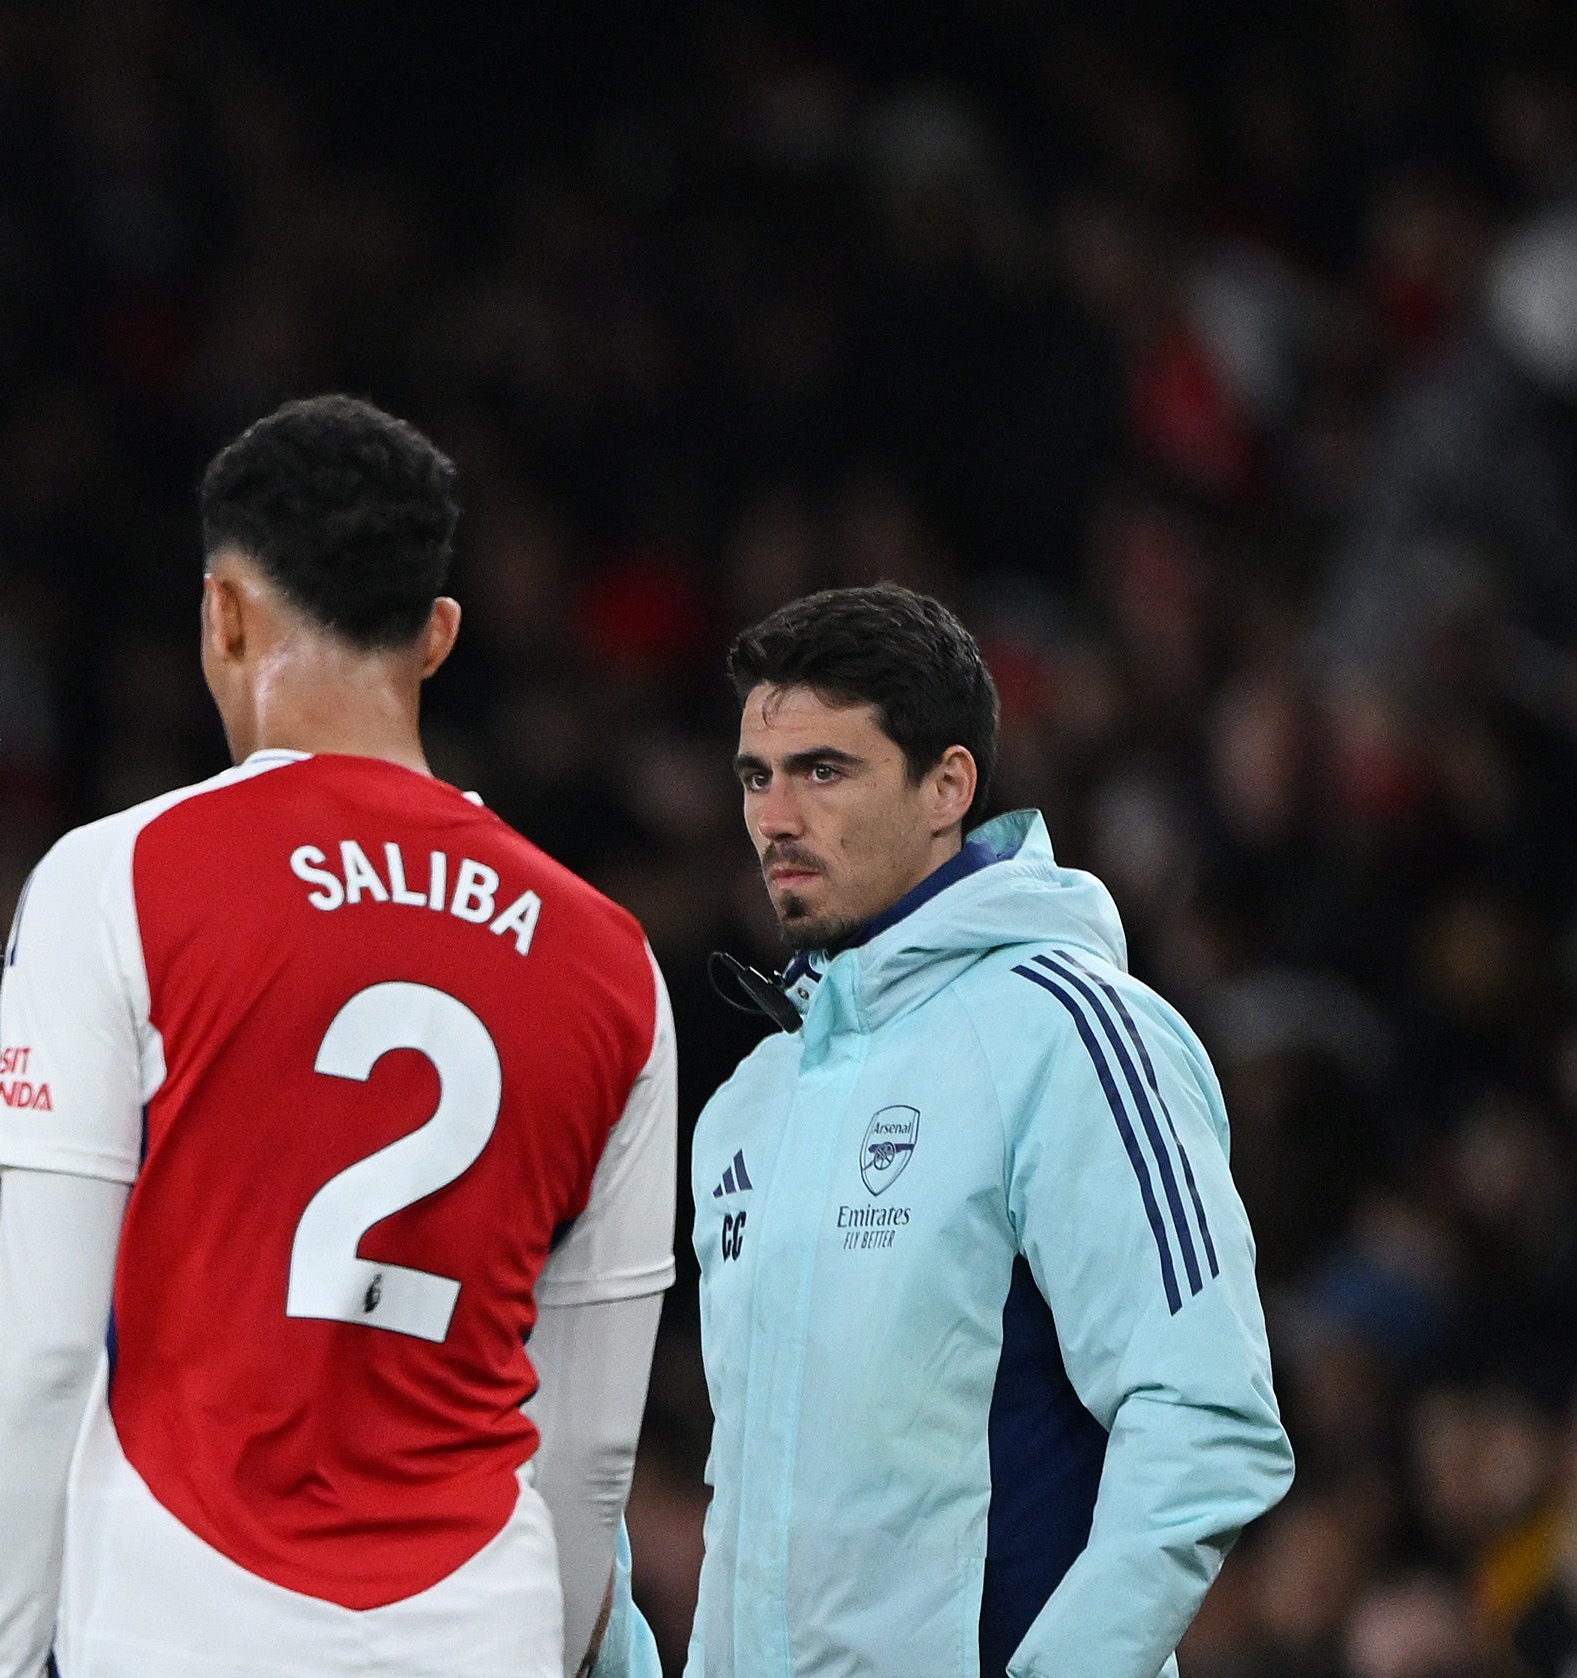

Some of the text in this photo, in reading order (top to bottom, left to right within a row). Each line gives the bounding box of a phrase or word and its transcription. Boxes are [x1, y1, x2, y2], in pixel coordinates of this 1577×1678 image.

[290, 840, 542, 956] SALIBA
[0, 1047, 31, 1074] SIT
[873, 1122, 912, 1135] Arsenal
[286, 980, 502, 1343] 2
[837, 1204, 912, 1228] Emirates
[721, 1211, 747, 1262] CC
[843, 1230, 896, 1250] FLY BETTER
